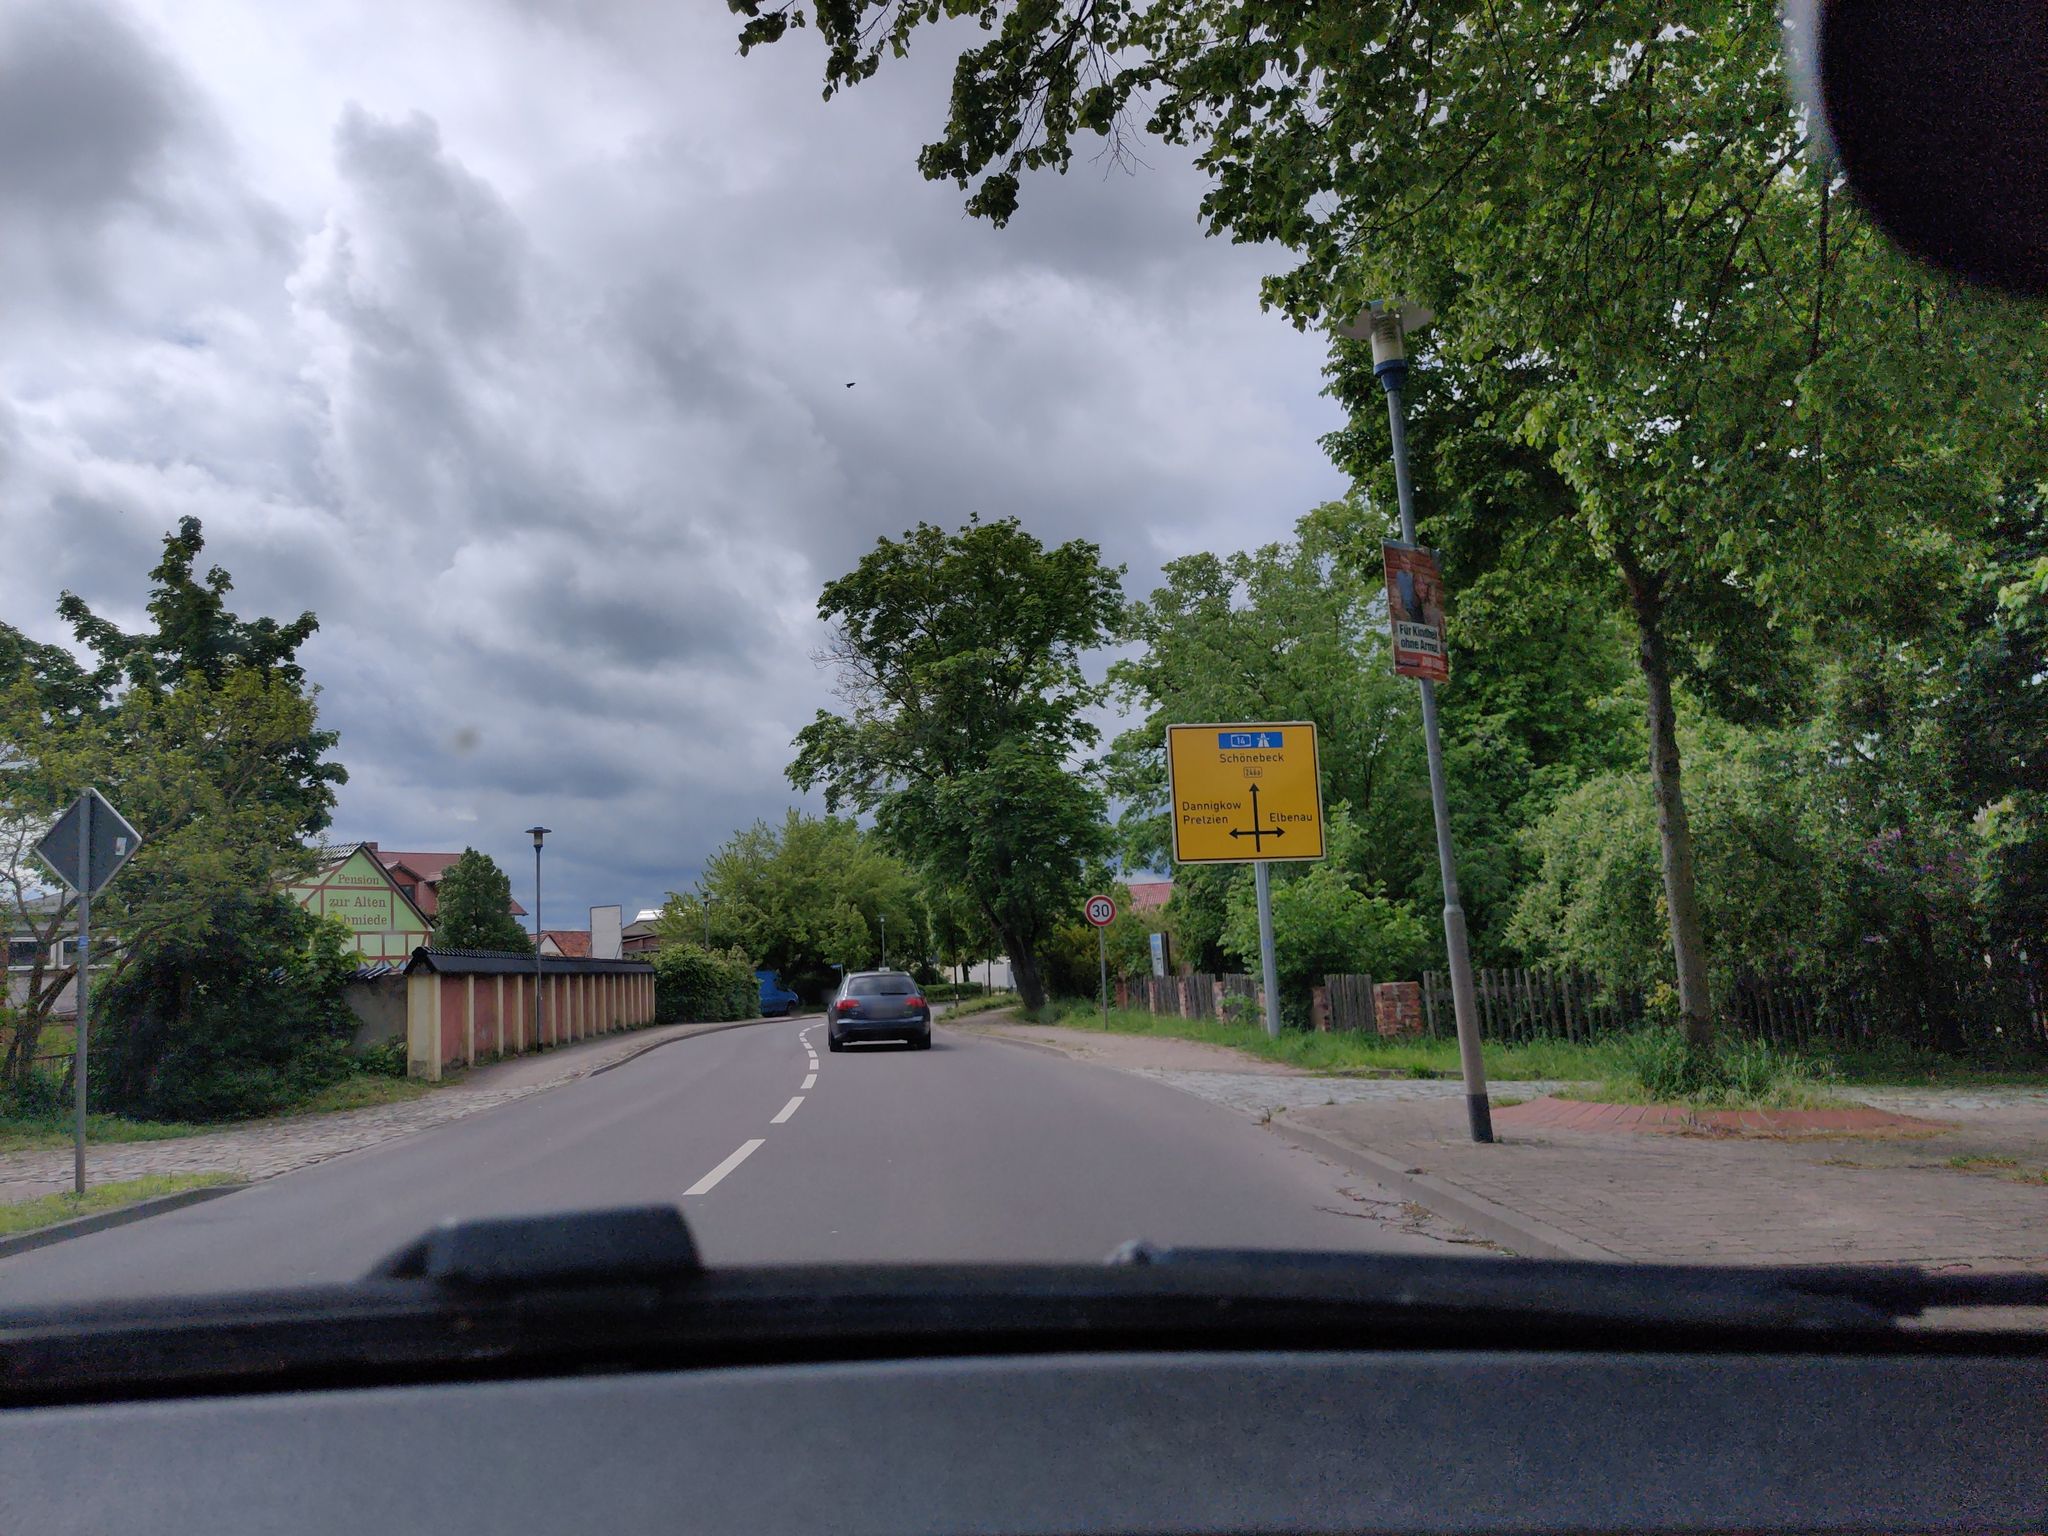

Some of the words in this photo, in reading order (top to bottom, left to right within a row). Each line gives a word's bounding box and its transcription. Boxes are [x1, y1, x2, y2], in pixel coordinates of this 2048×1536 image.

[1399, 623, 1411, 635] Für
[1400, 637, 1419, 650] ohne
[1236, 736, 1246, 745] 14
[1219, 753, 1284, 764] Schönebeck
[1182, 801, 1242, 813] Dannigkow
[1183, 815, 1229, 825] Pretzien
[1269, 812, 1313, 823] Elbenau
[338, 873, 380, 885] Pension
[328, 897, 351, 908] zur
[354, 895, 386, 908] Alten
[1092, 904, 1109, 918] 30
[342, 914, 388, 926] hmiede
